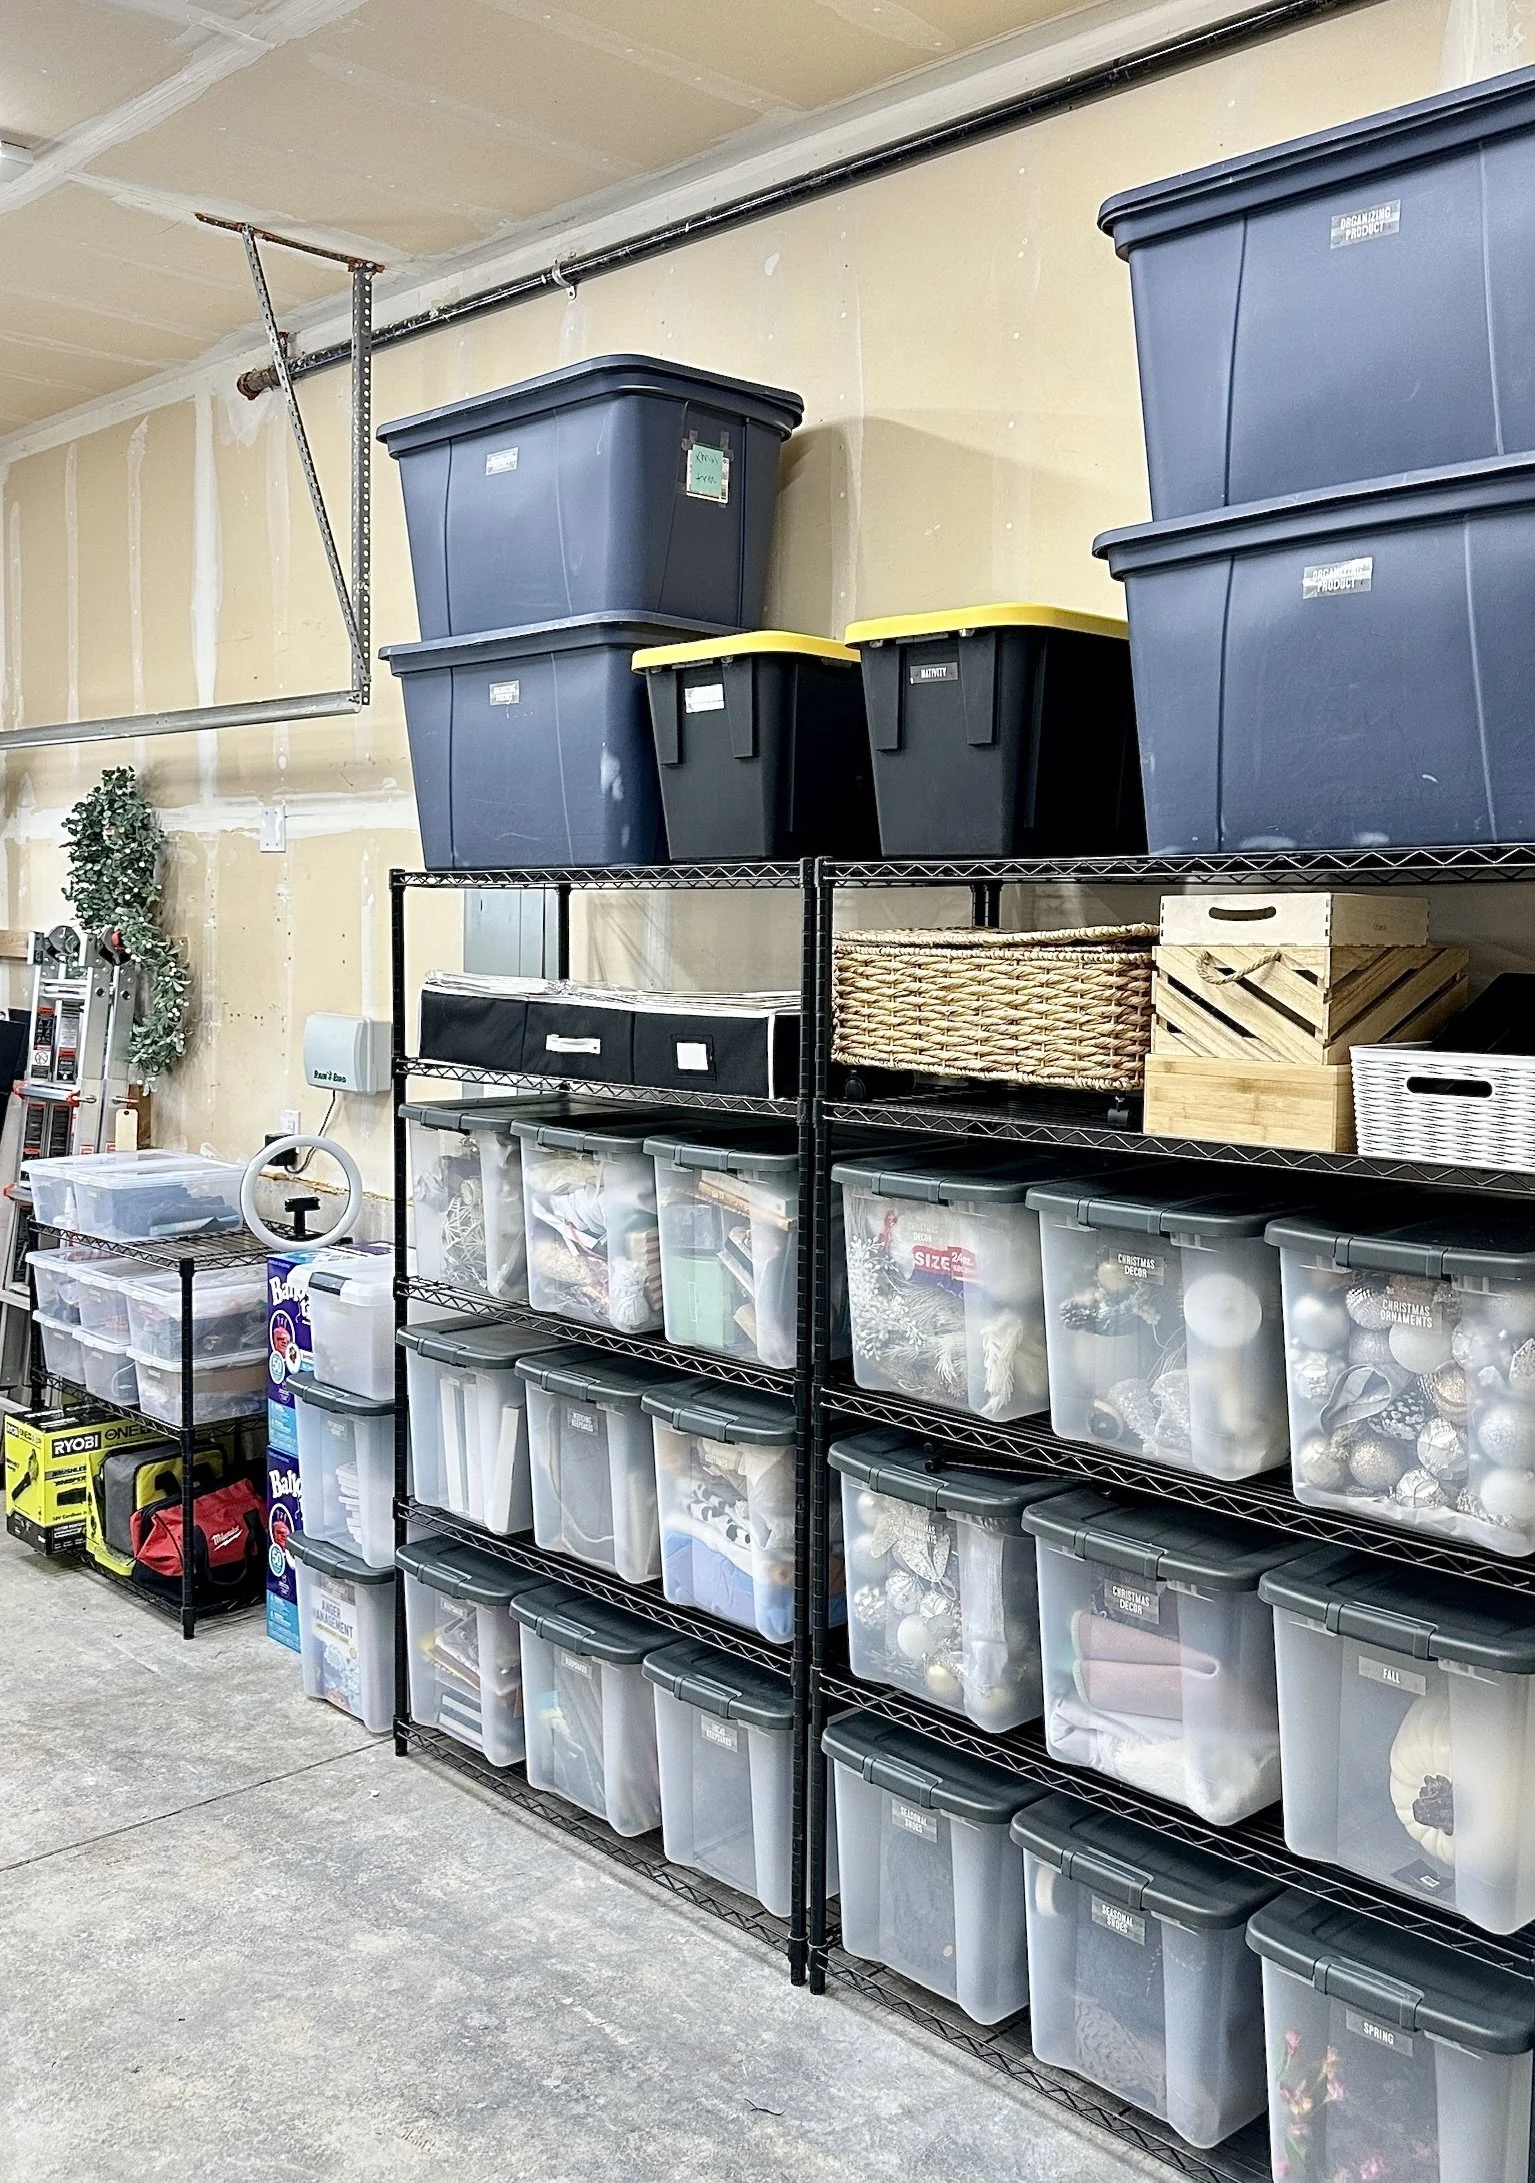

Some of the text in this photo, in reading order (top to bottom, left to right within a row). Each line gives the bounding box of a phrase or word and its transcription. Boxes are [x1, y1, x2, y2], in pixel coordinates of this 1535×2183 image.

[1340, 206, 1391, 231] ORGANIZING
[1345, 221, 1385, 241] PRODUCT
[1317, 578, 1356, 593] PRODUCT
[914, 1251, 951, 1272] SIZE
[1117, 1253, 1155, 1270] CHRISTMAS
[1124, 1264, 1148, 1279] DECOR
[1382, 1299, 1431, 1317] CHRISTMAS
[1380, 1309, 1433, 1329] ORNAMENTS
[53, 1435, 99, 1455] RYOBI
[1112, 1585, 1150, 1607] CHRISTMAS
[1119, 1598, 1143, 1615] DECOR
[1383, 1667, 1401, 1684] FALL
[1101, 1904, 1134, 1928] SEASONAL
[1106, 1915, 1128, 1934] SHOES
[1363, 2021, 1394, 2045] SPRING
